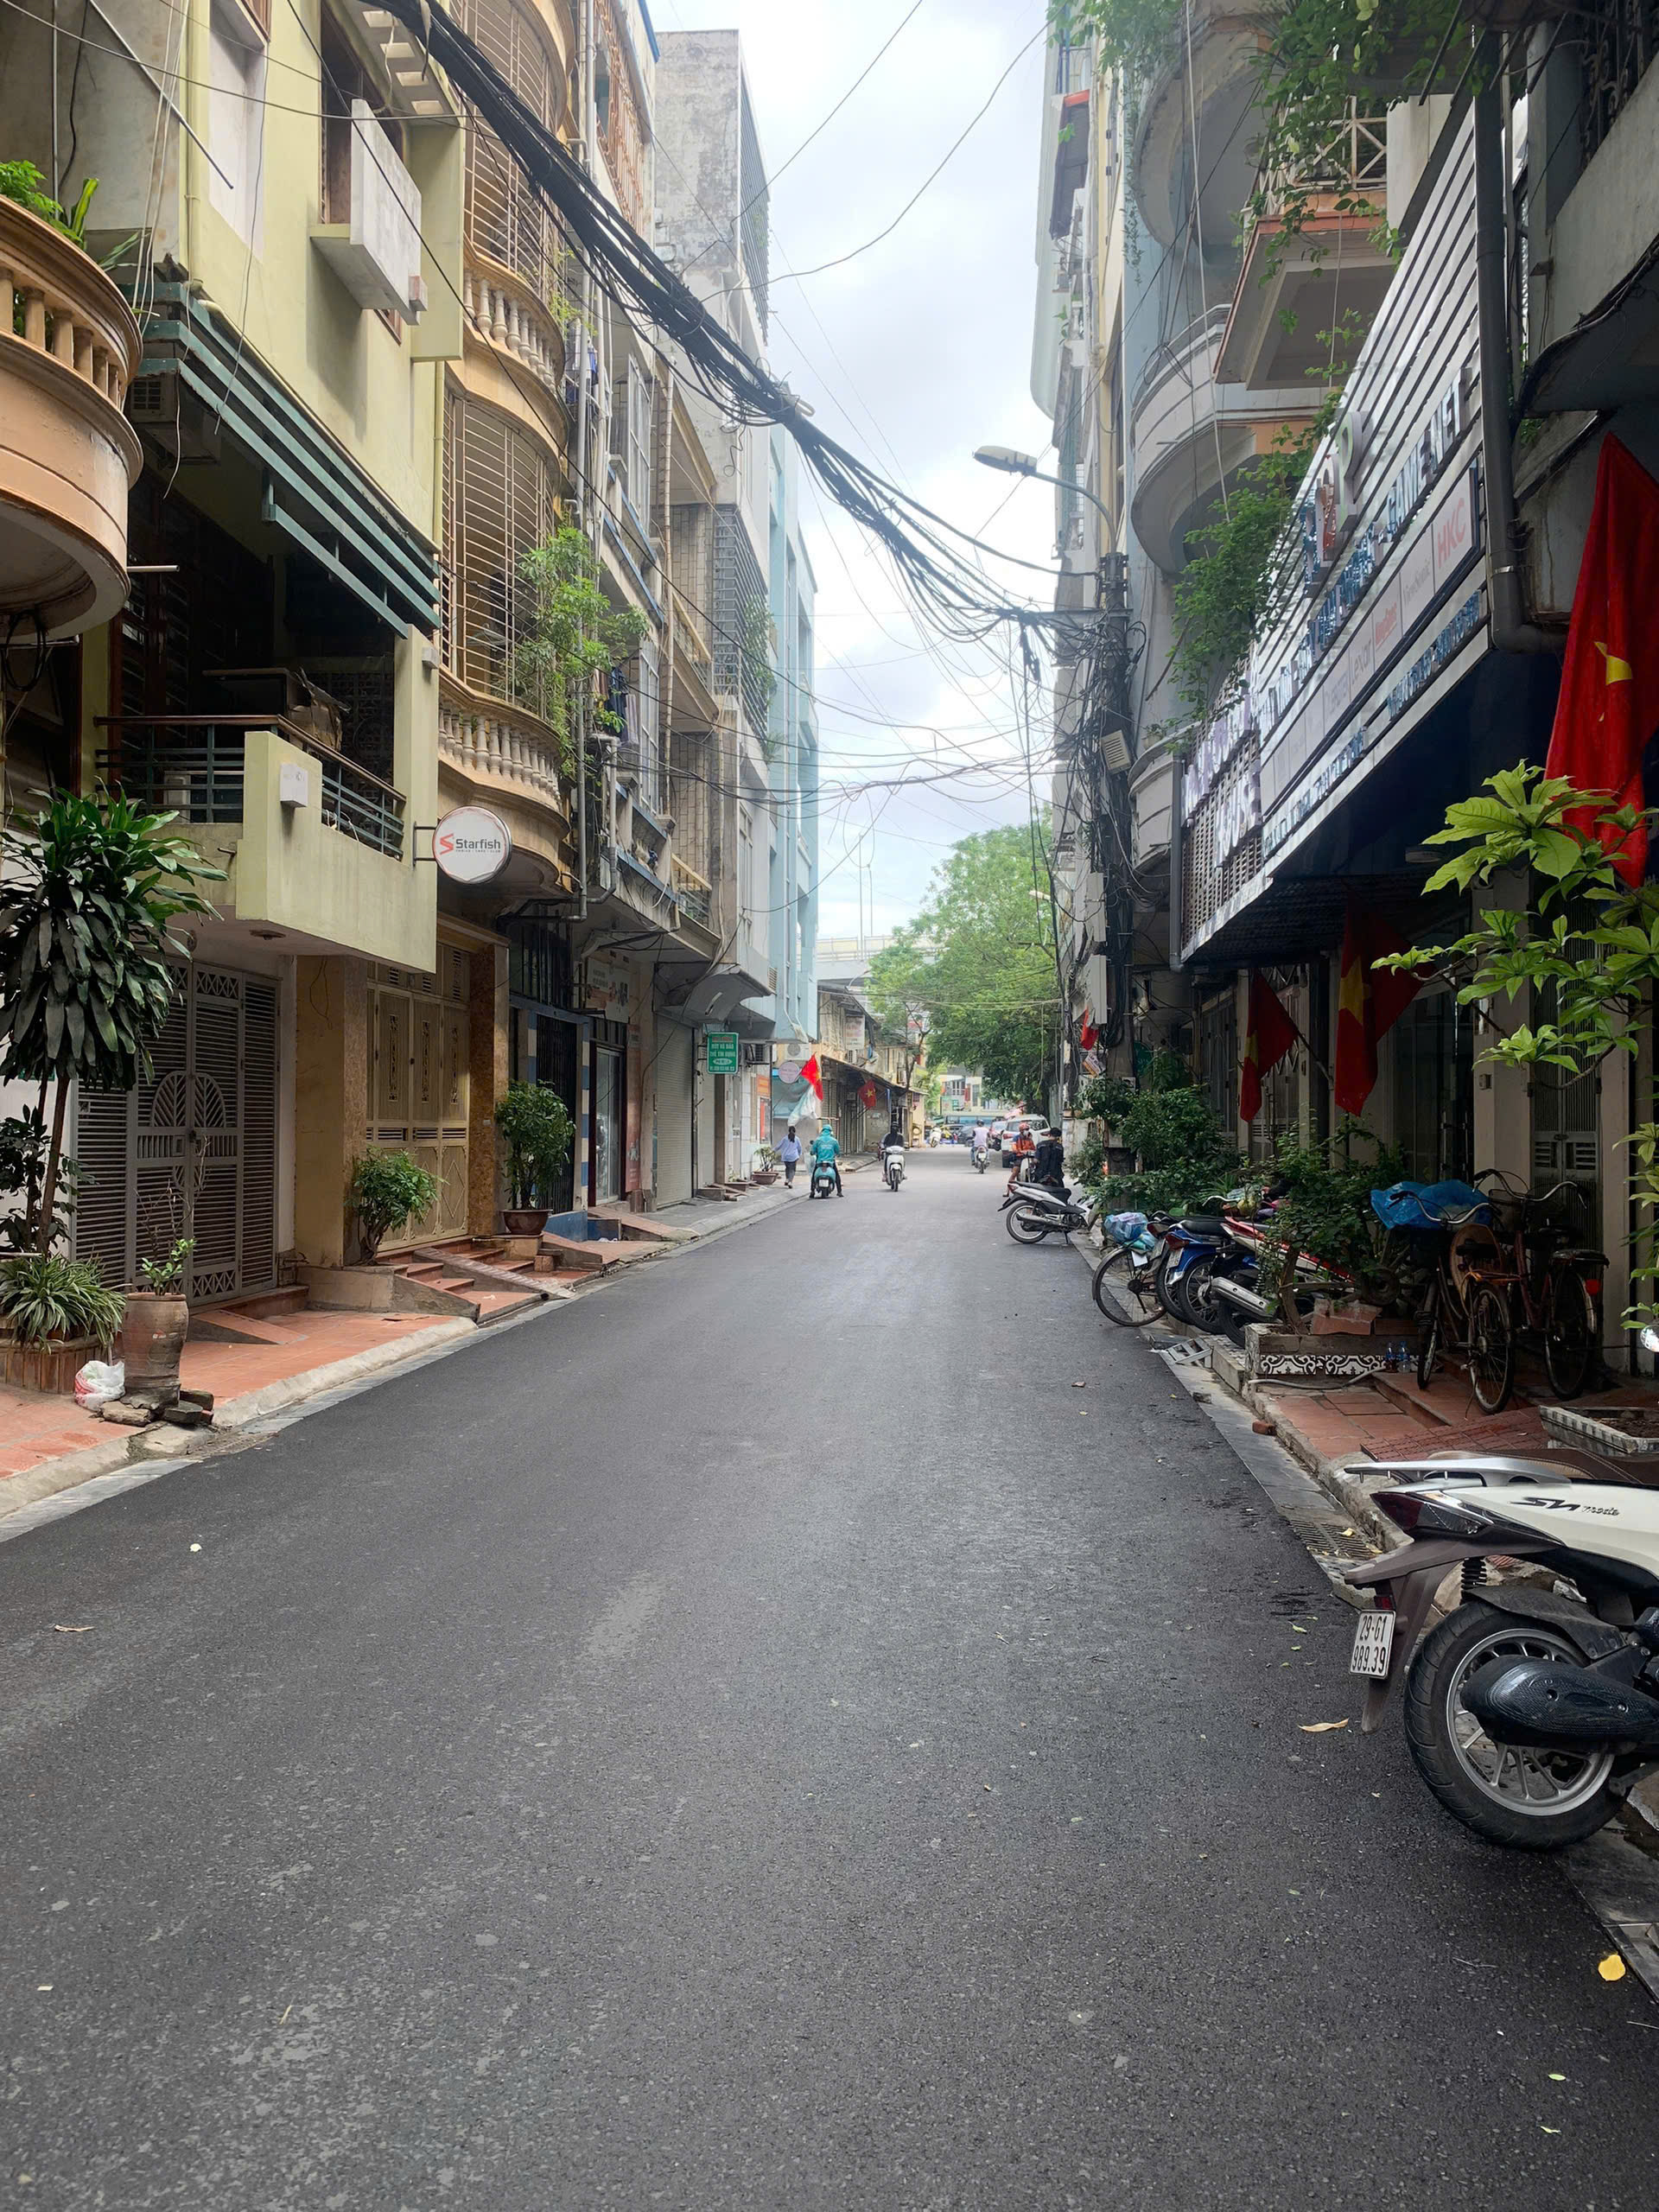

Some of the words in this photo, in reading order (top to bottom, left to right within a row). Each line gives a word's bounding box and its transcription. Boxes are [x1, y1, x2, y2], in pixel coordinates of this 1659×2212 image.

[1387, 429, 1427, 542] GAME
[1431, 369, 1462, 473] NET
[1437, 497, 1466, 568] HKC
[455, 838, 501, 849] Starfish
[1359, 1615, 1388, 1642] 29-G1
[1352, 1644, 1386, 1674] 989.39
